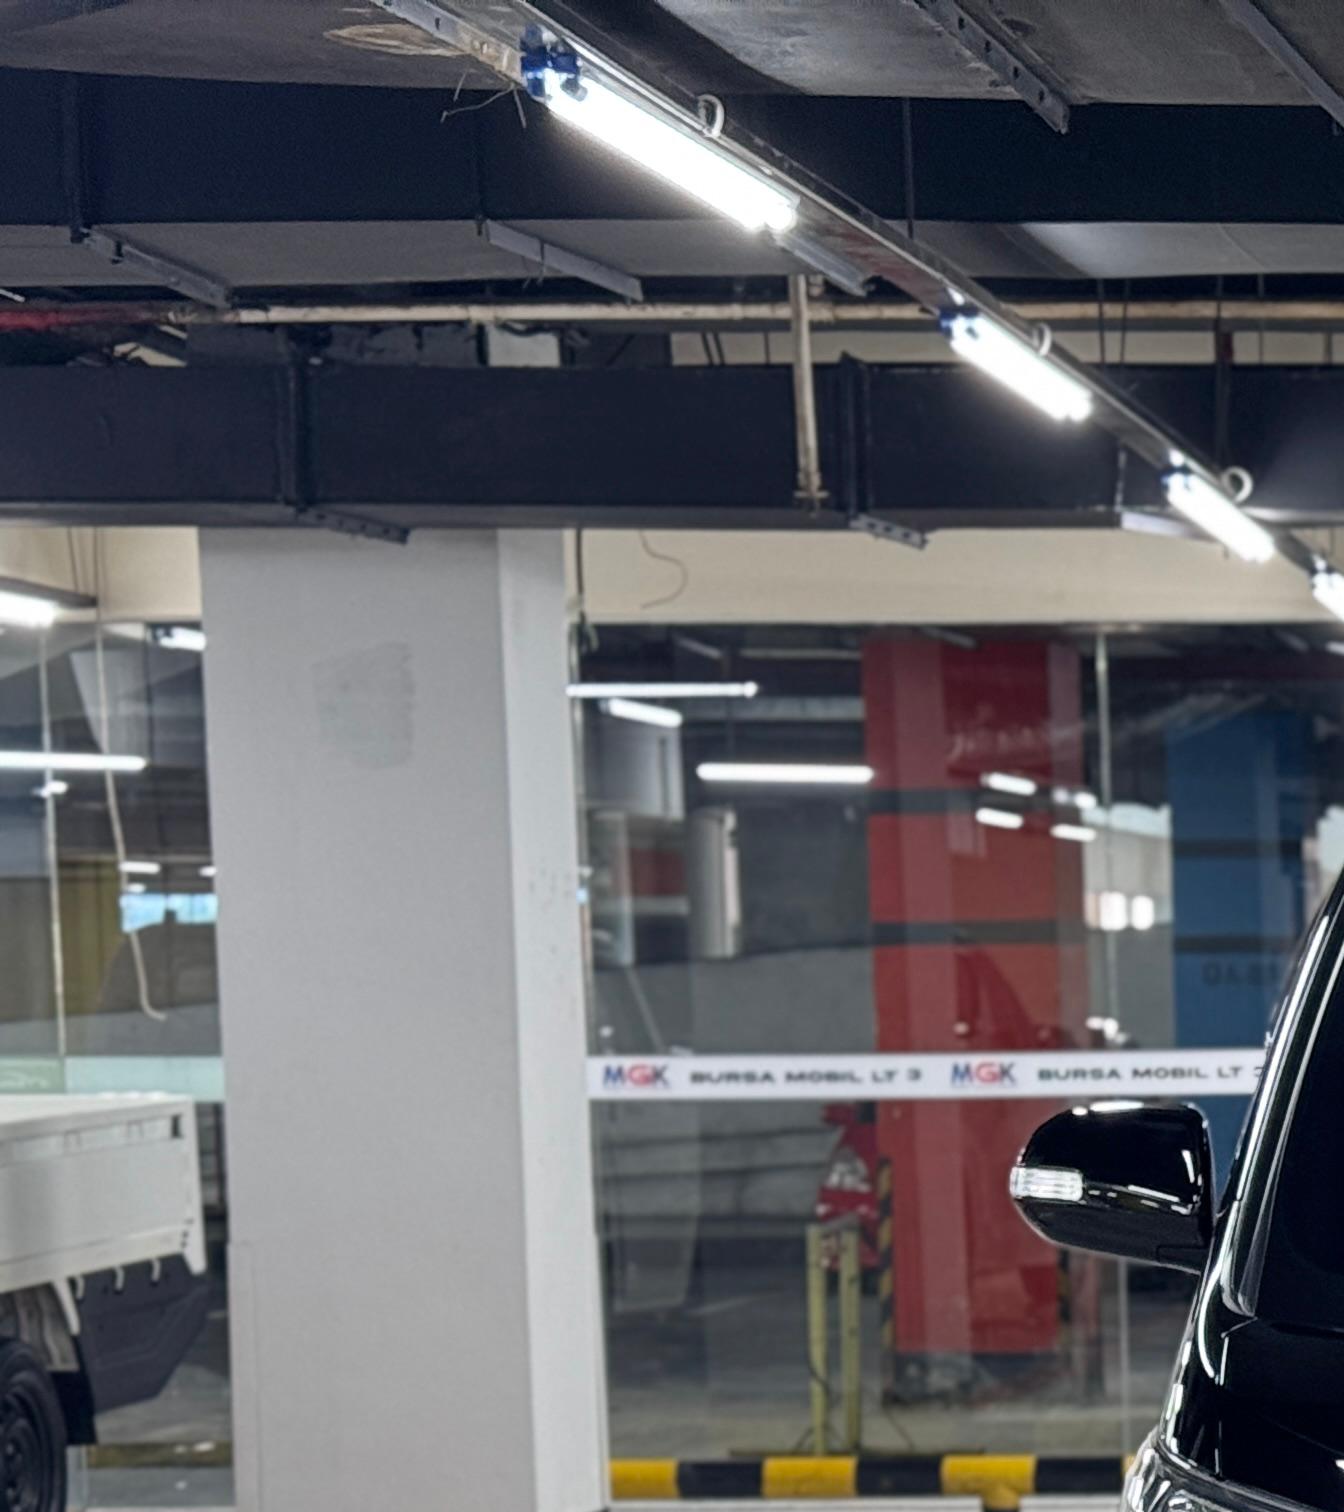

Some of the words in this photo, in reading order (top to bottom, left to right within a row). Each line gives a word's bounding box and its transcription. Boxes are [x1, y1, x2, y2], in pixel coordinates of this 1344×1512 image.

[603, 1064, 671, 1088] MGK
[690, 1069, 775, 1084] BURSA
[785, 1069, 862, 1084] MOBIL
[872, 1069, 897, 1083] LT
[906, 1067, 922, 1082] 3
[951, 1062, 1017, 1086] MGK
[1038, 1067, 1121, 1081] BURSA
[1132, 1066, 1208, 1080] MOBIL
[1218, 1066, 1243, 1078] LT
